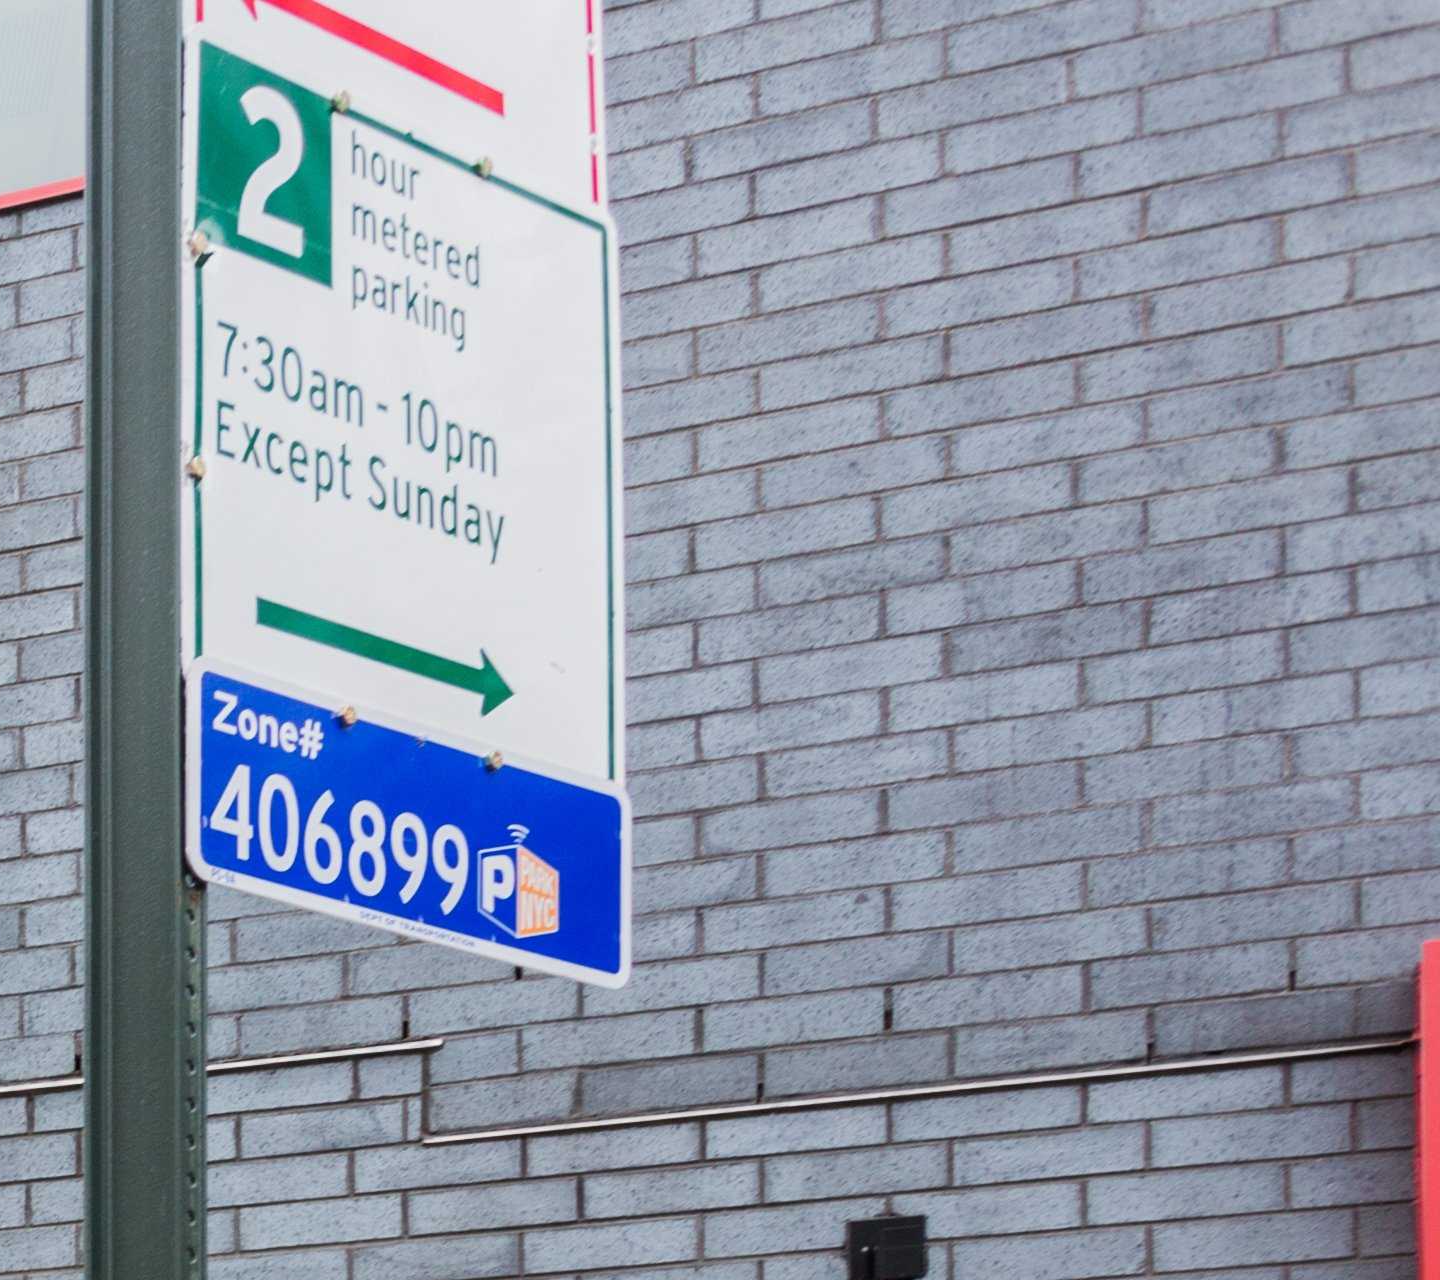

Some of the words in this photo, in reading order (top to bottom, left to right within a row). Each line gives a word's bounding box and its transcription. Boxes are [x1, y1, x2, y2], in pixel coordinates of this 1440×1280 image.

[237, 85, 304, 259] 2
[351, 131, 419, 200] hour
[352, 202, 481, 288] metered
[352, 263, 467, 352] parking
[218, 321, 364, 428] 7:30am
[401, 392, 497, 477] 10pm
[216, 401, 352, 503] Except
[368, 455, 504, 565] Sunday
[212, 690, 324, 760] Zone#
[209, 764, 469, 916] 406899
